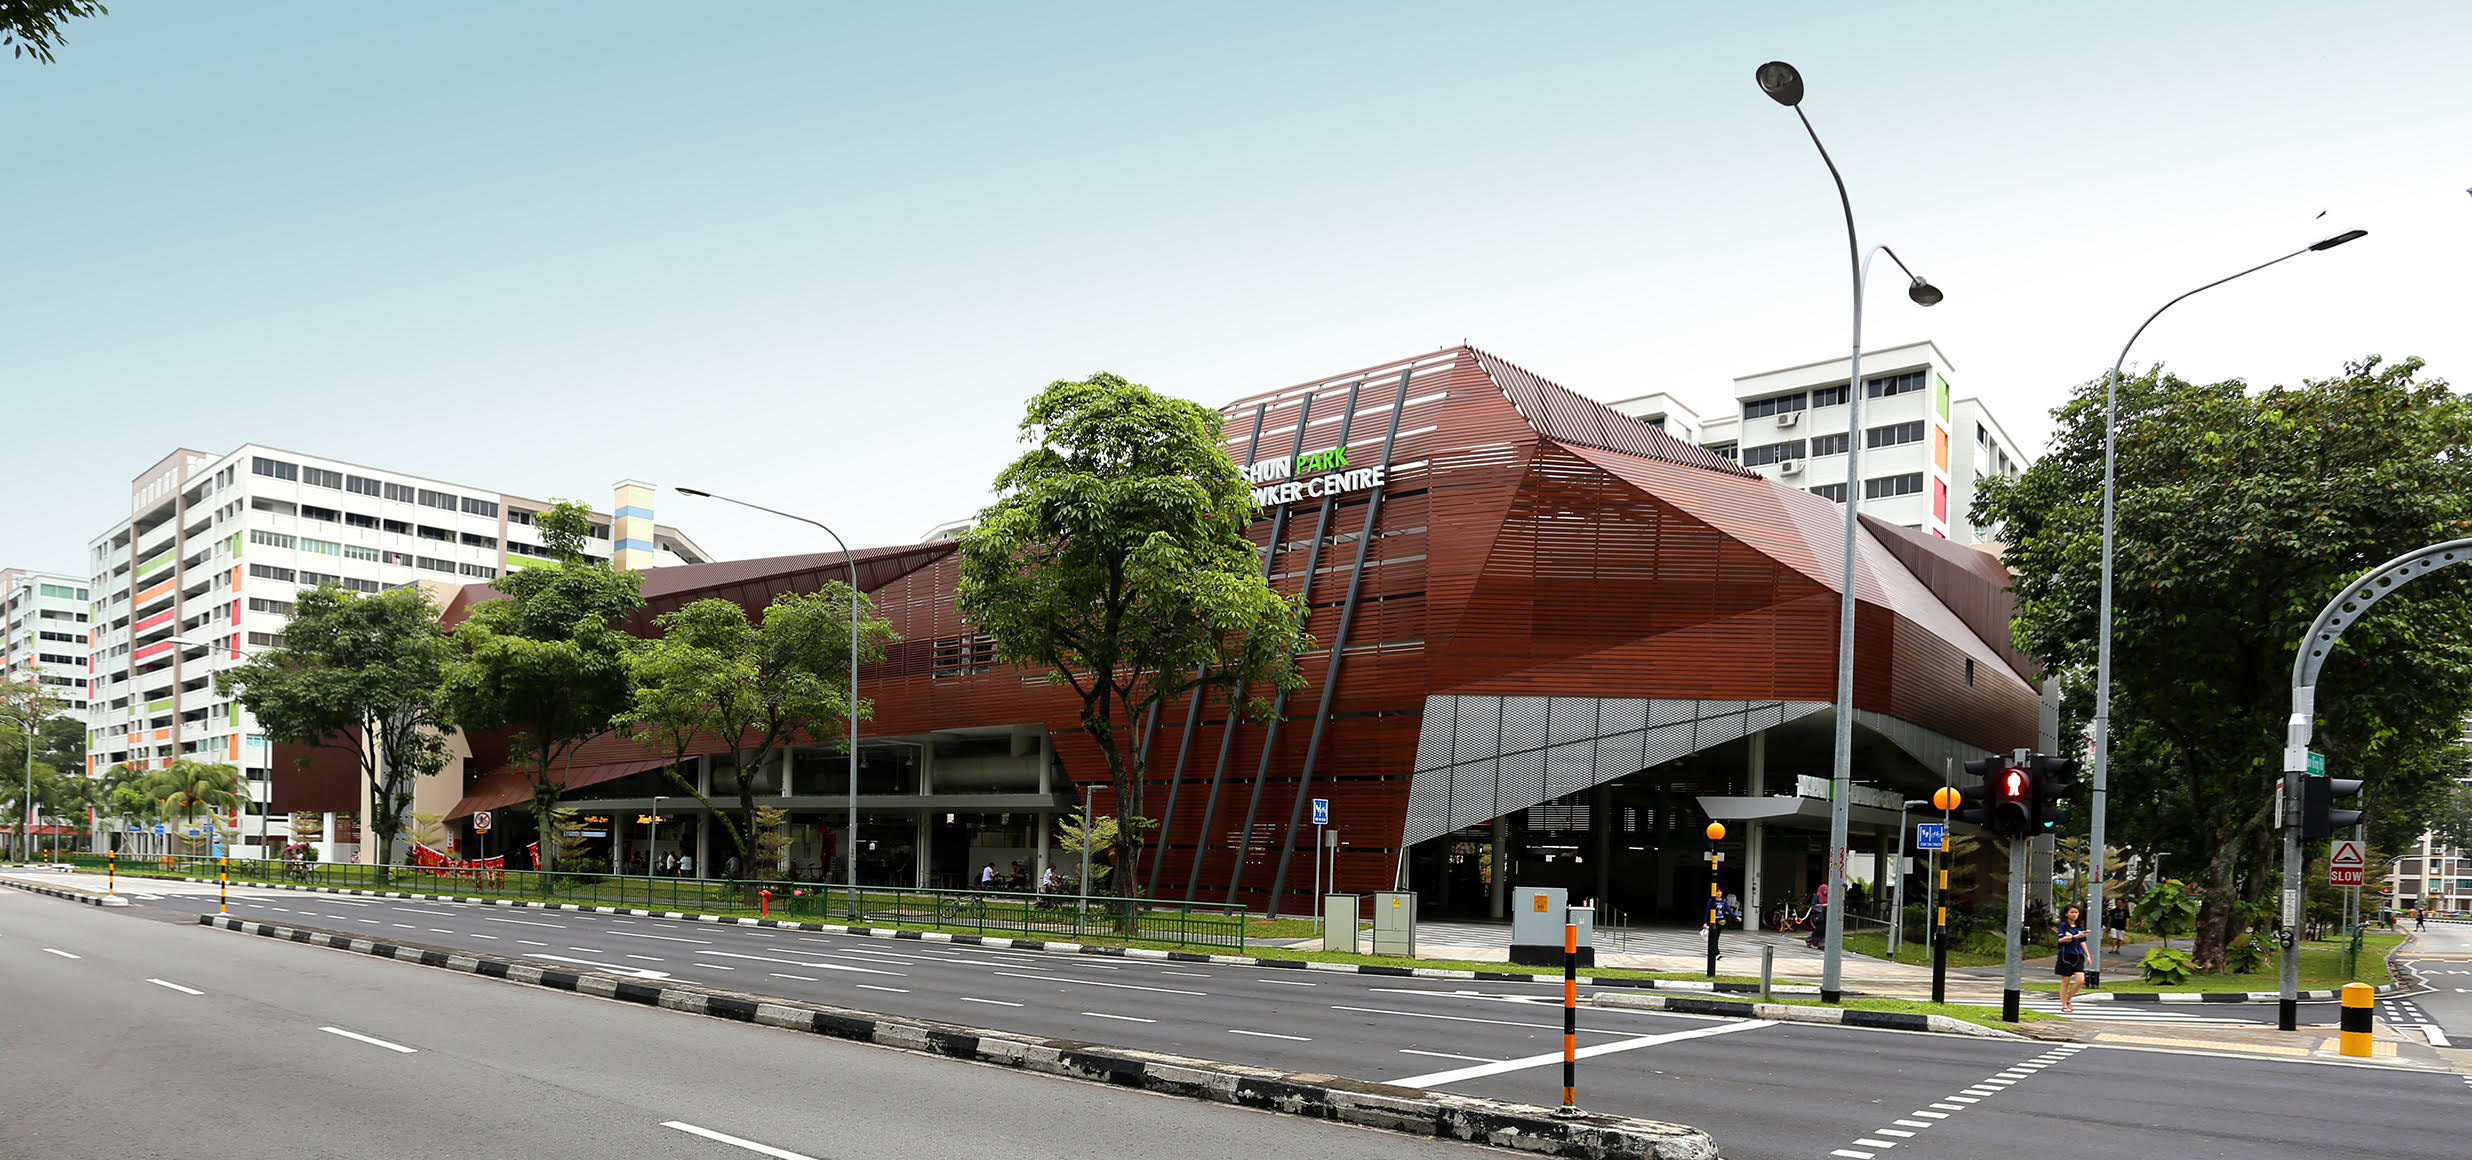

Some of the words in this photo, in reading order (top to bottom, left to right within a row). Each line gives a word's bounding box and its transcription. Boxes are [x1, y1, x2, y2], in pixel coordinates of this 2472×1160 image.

[1239, 456, 1291, 485] SHUN
[1296, 446, 1349, 475] PARK
[1250, 481, 1304, 508] WKER
[1308, 465, 1386, 498] CENTRE
[2331, 870, 2362, 881] SLOW
